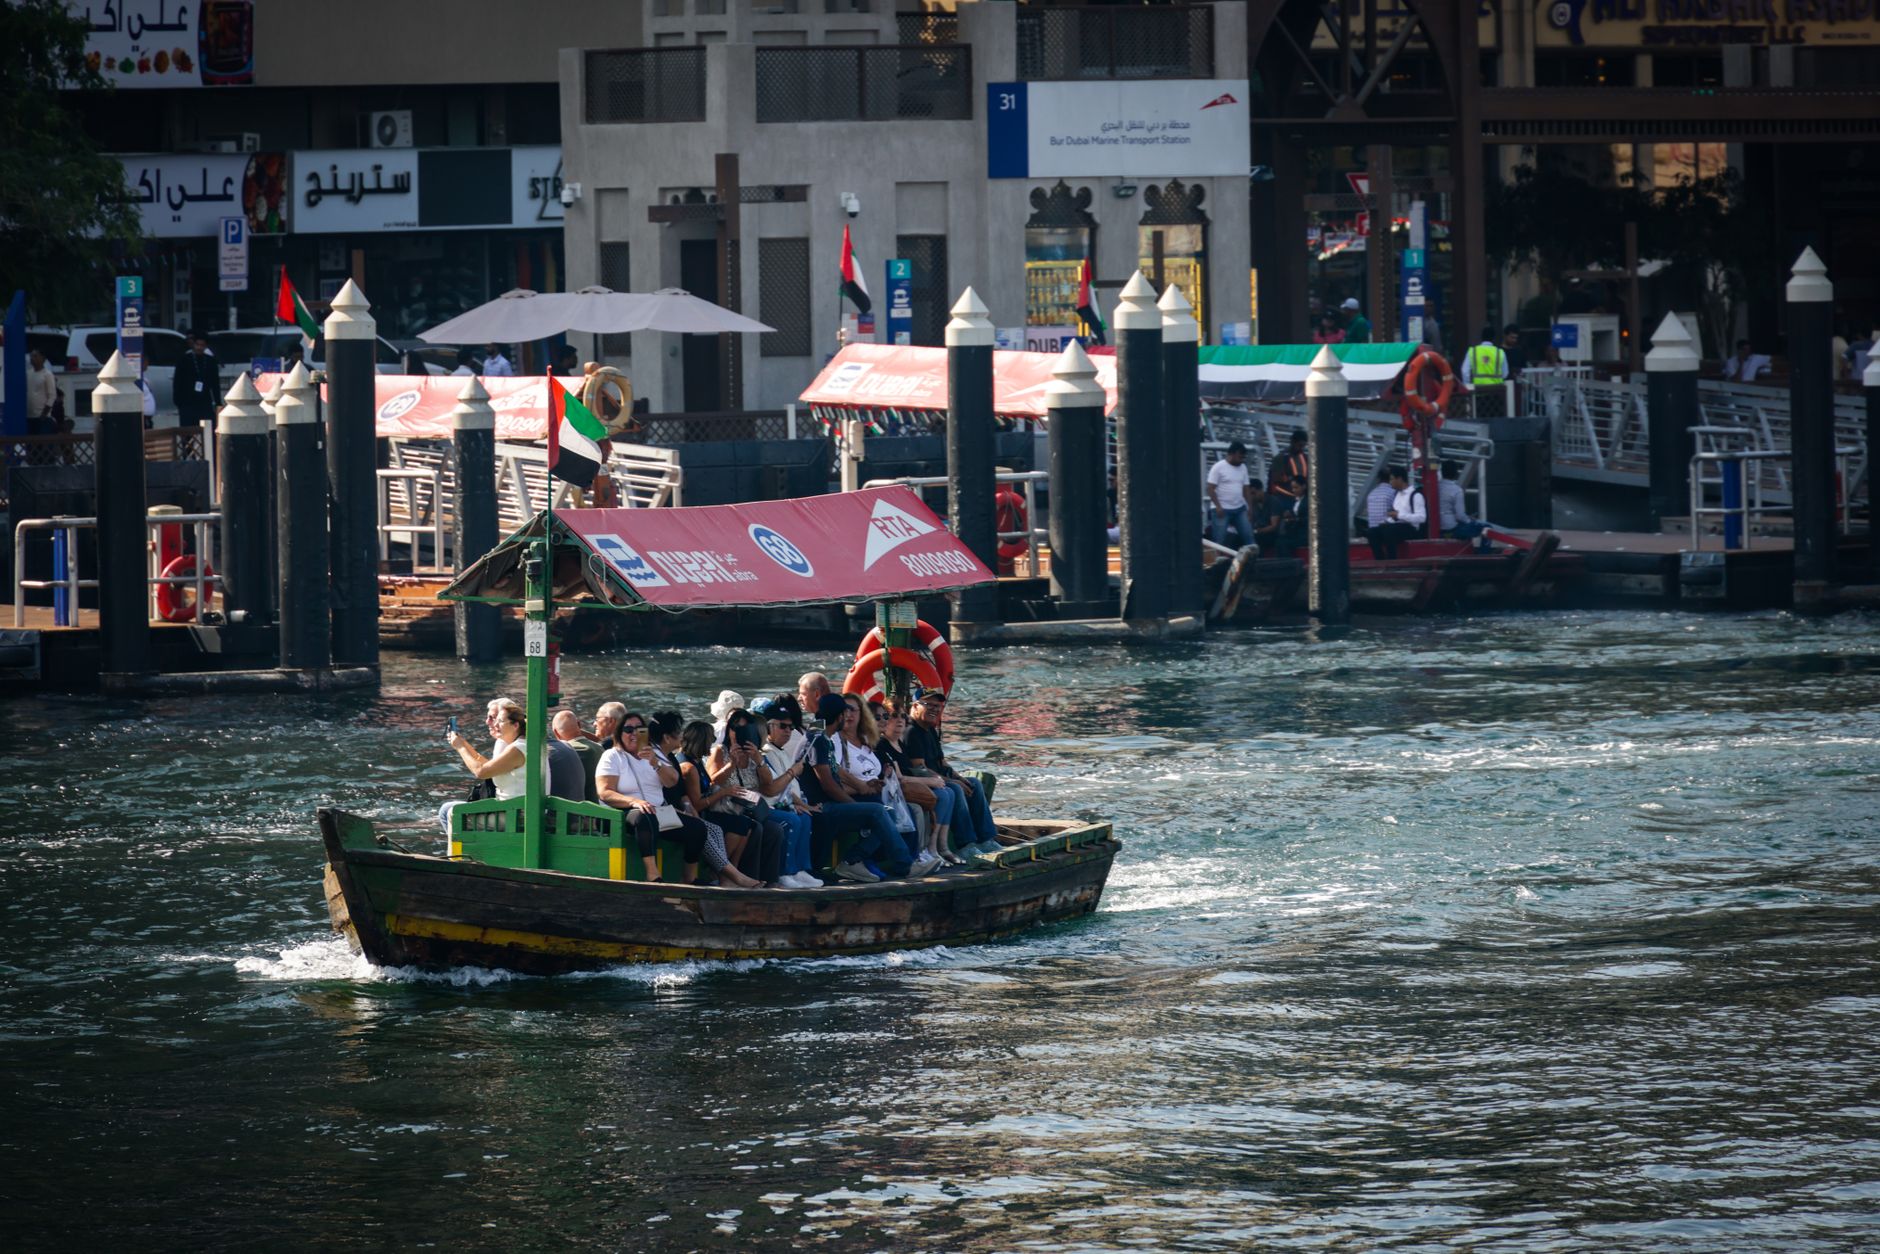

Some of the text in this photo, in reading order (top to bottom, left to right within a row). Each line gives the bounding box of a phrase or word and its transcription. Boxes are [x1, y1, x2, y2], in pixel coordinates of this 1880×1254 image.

[1000, 94, 1016, 110] 31
[1100, 120, 1190, 133] محطة بر دبي للنقل البحري
[1050, 134, 1191, 146] Bur Dubai Marine Transport Station
[166, 168, 234, 222] علي
[227, 220, 239, 243] P
[1411, 252, 1418, 265] 1
[896, 262, 905, 276] 2
[127, 279, 137, 294] 3
[1028, 338, 1060, 353] DUB
[870, 515, 923, 539] RTA
[758, 535, 804, 565] 68
[899, 550, 978, 577] 8009090
[530, 641, 541, 654] 68
